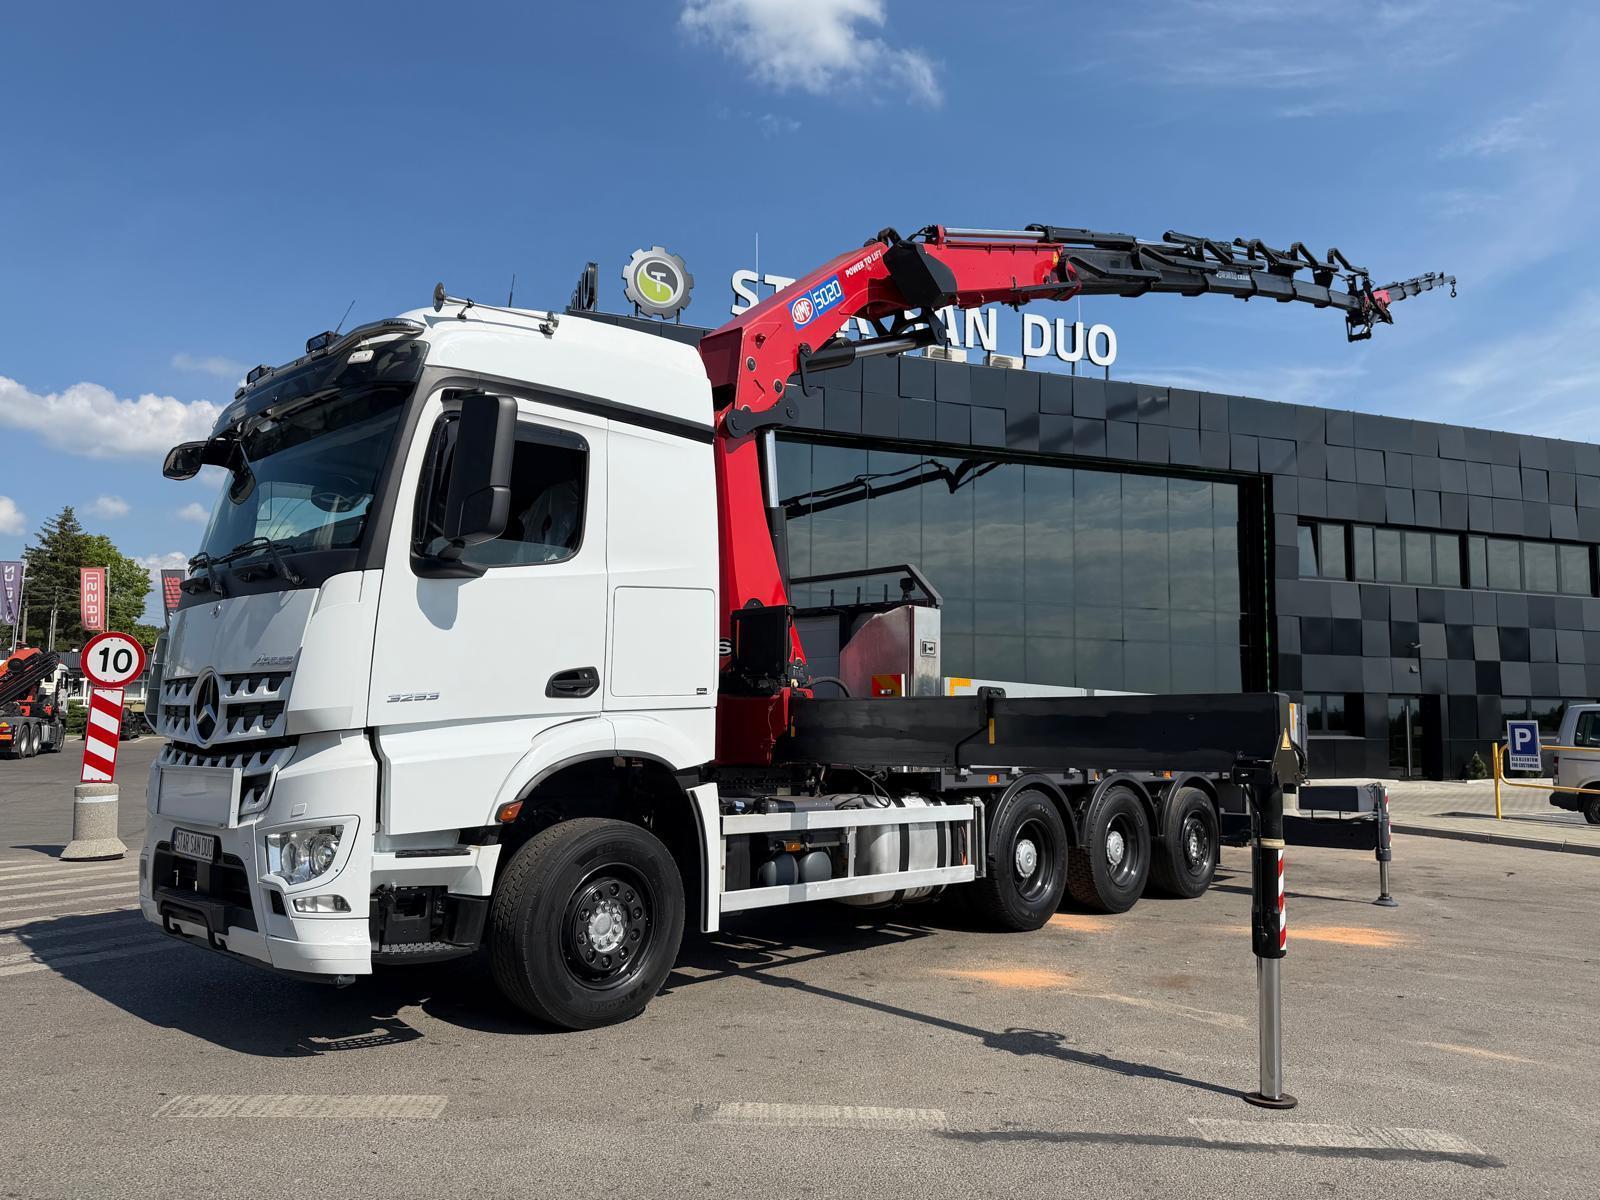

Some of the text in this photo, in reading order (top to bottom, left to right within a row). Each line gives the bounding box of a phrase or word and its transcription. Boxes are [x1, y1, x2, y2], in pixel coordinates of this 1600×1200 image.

[844, 249, 882, 278] POWER TO LIFT
[793, 280, 842, 322] HMF 5020
[1022, 313, 1117, 366] DUO
[98, 647, 133, 673] 10
[1514, 728, 1532, 751] P
[176, 831, 214, 858] STAR SAN DUO
